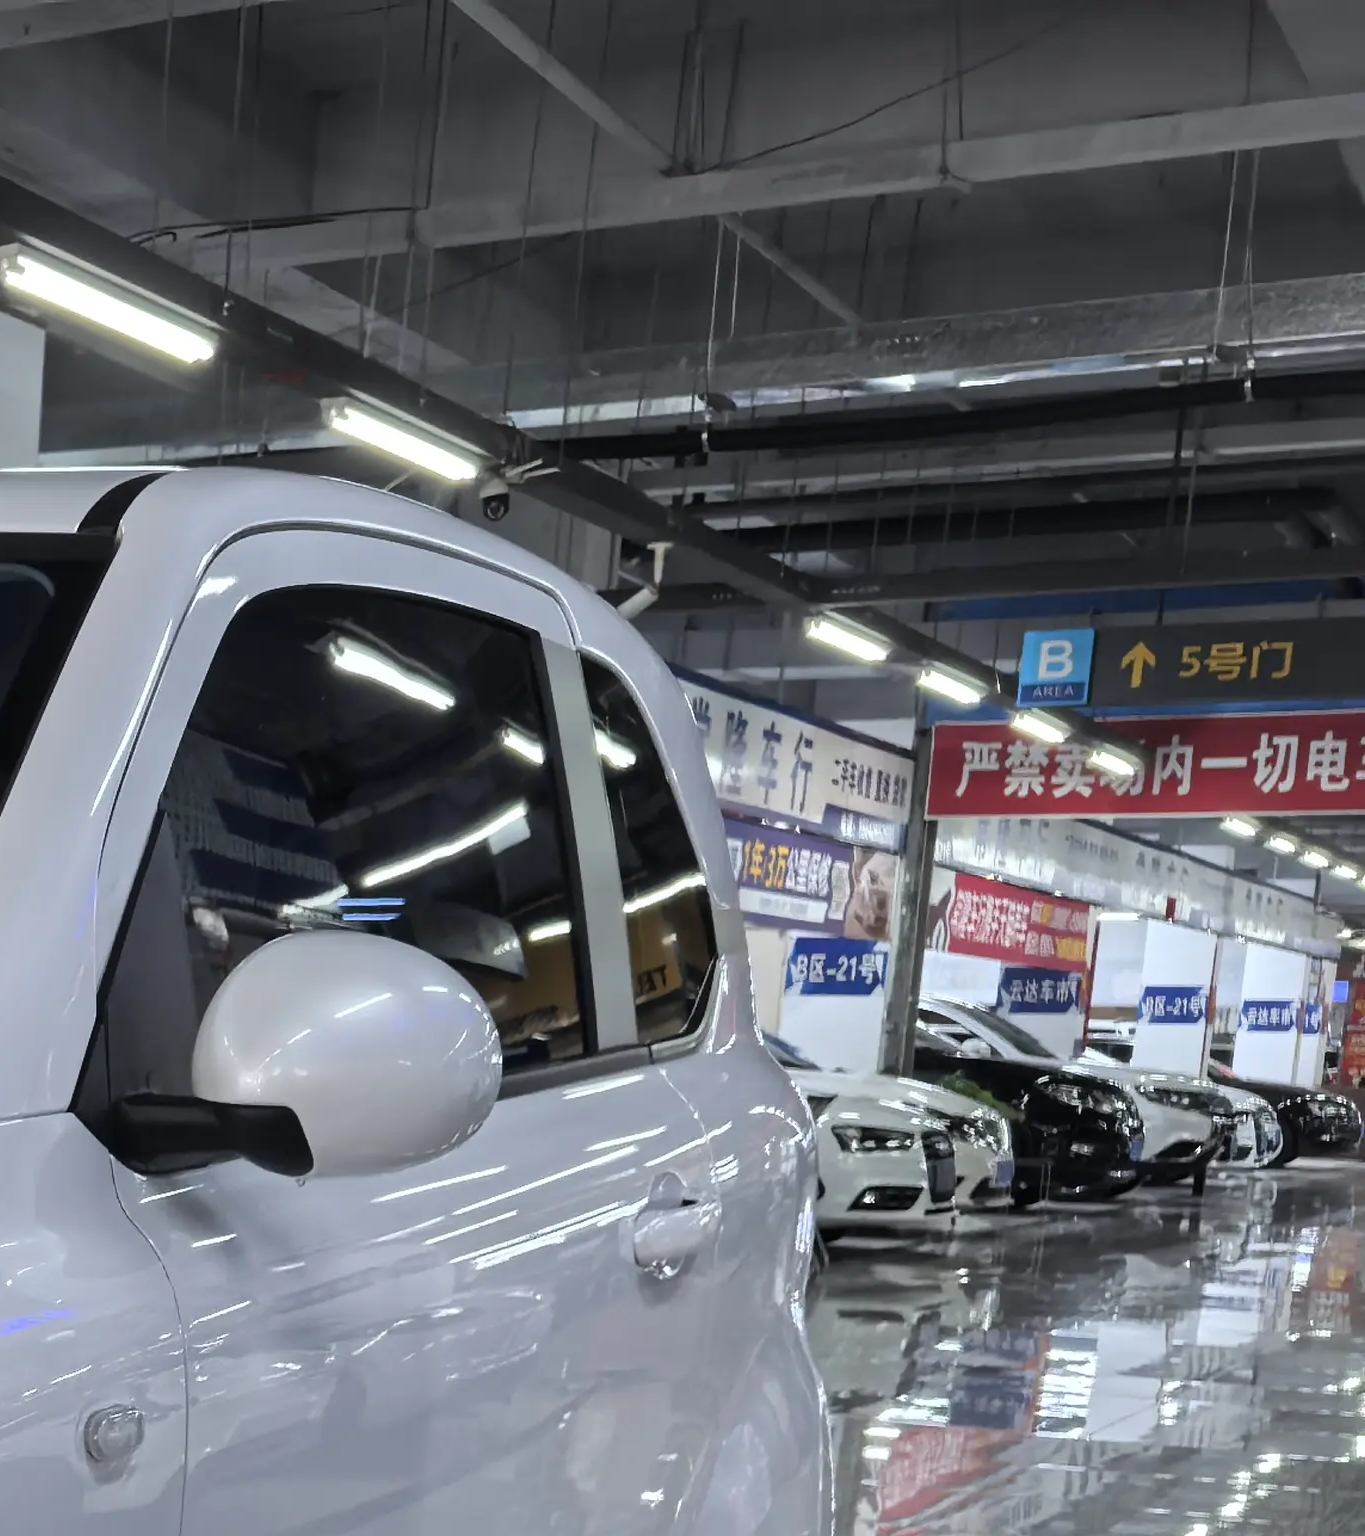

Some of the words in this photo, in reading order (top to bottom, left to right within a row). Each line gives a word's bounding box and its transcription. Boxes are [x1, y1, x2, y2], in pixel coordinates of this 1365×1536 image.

[1037, 639, 1073, 681] B
[1179, 641, 1295, 681] 5号门
[1032, 685, 1075, 698] AREA
